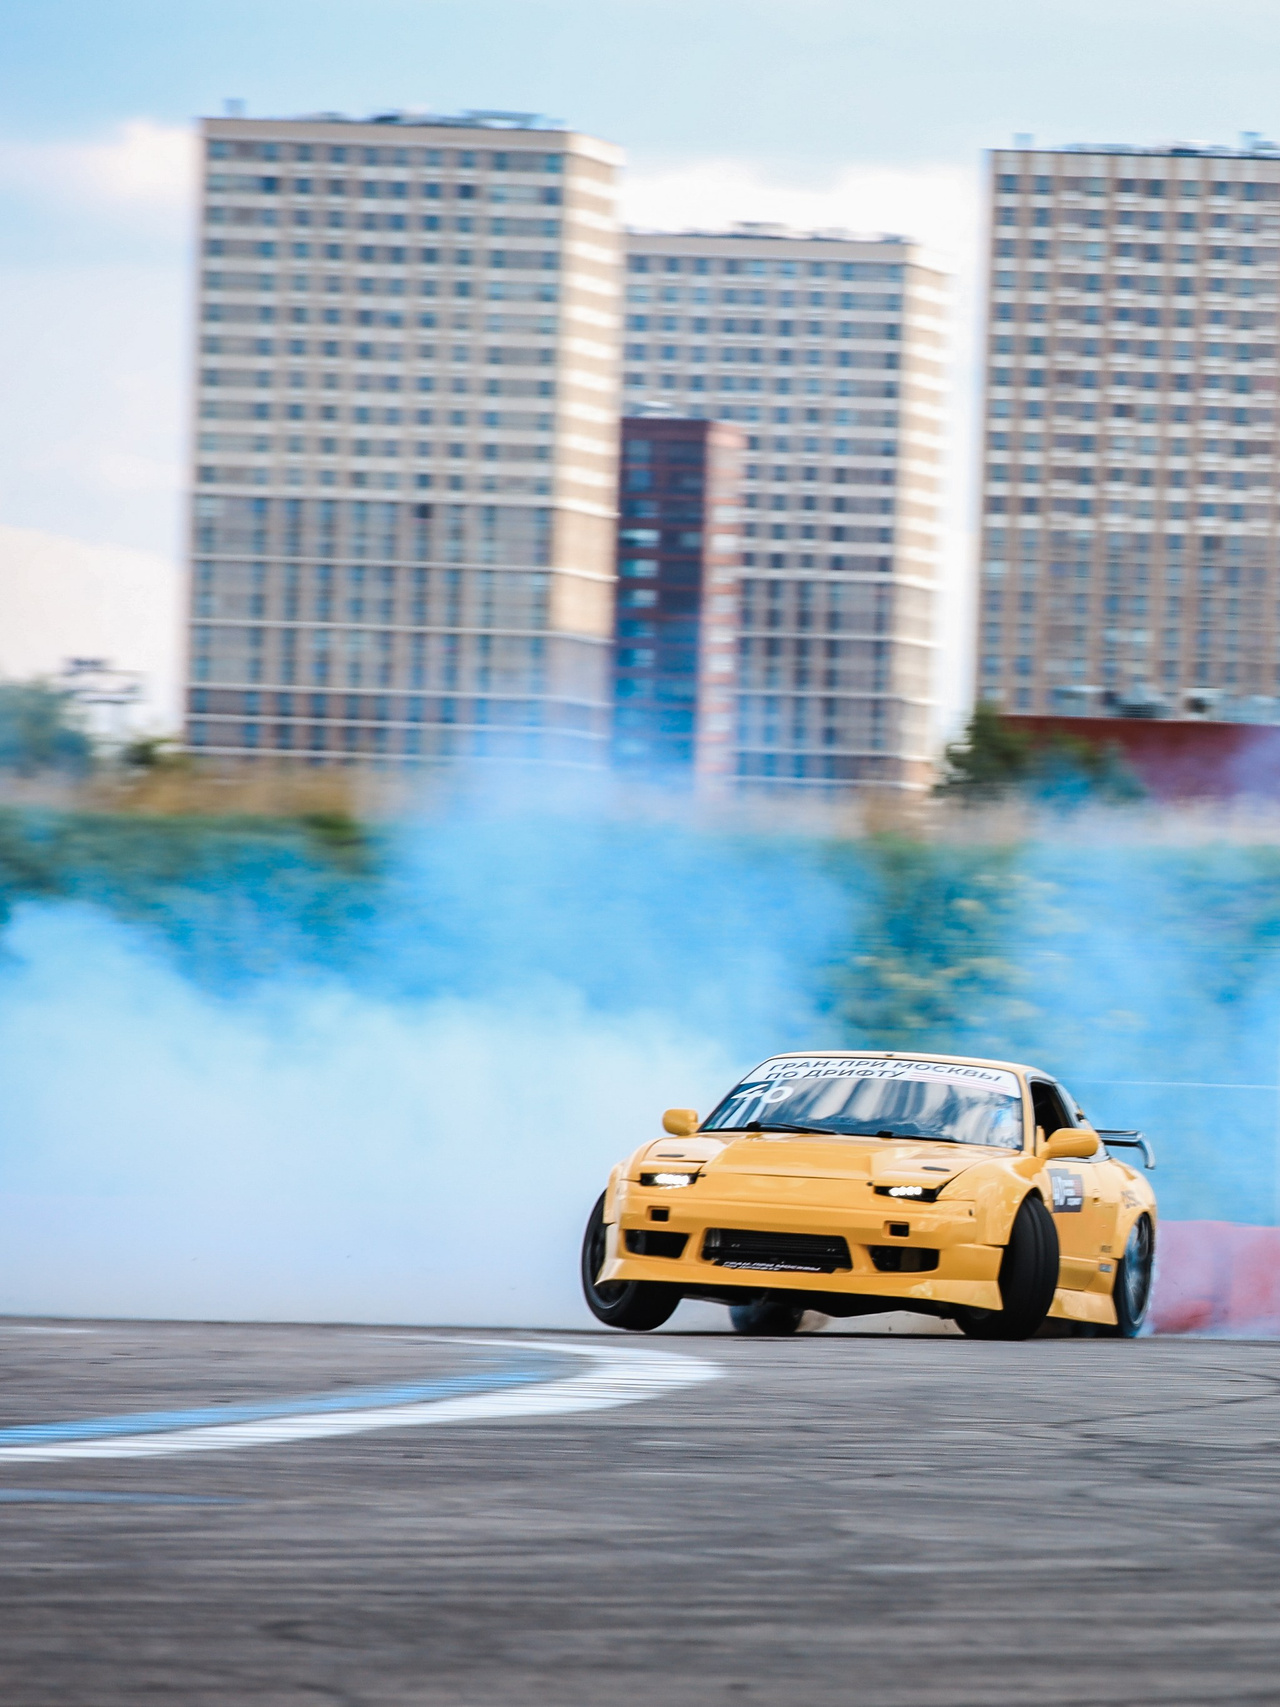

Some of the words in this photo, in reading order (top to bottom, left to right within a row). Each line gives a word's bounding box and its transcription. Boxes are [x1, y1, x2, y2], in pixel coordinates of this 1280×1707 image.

[765, 1071, 798, 1081] ПО
[802, 1068, 906, 1080] ДРИФТУ
[768, 1060, 889, 1072] ГРАН-ПРИ
[893, 1061, 1003, 1082] МОСКВЫ
